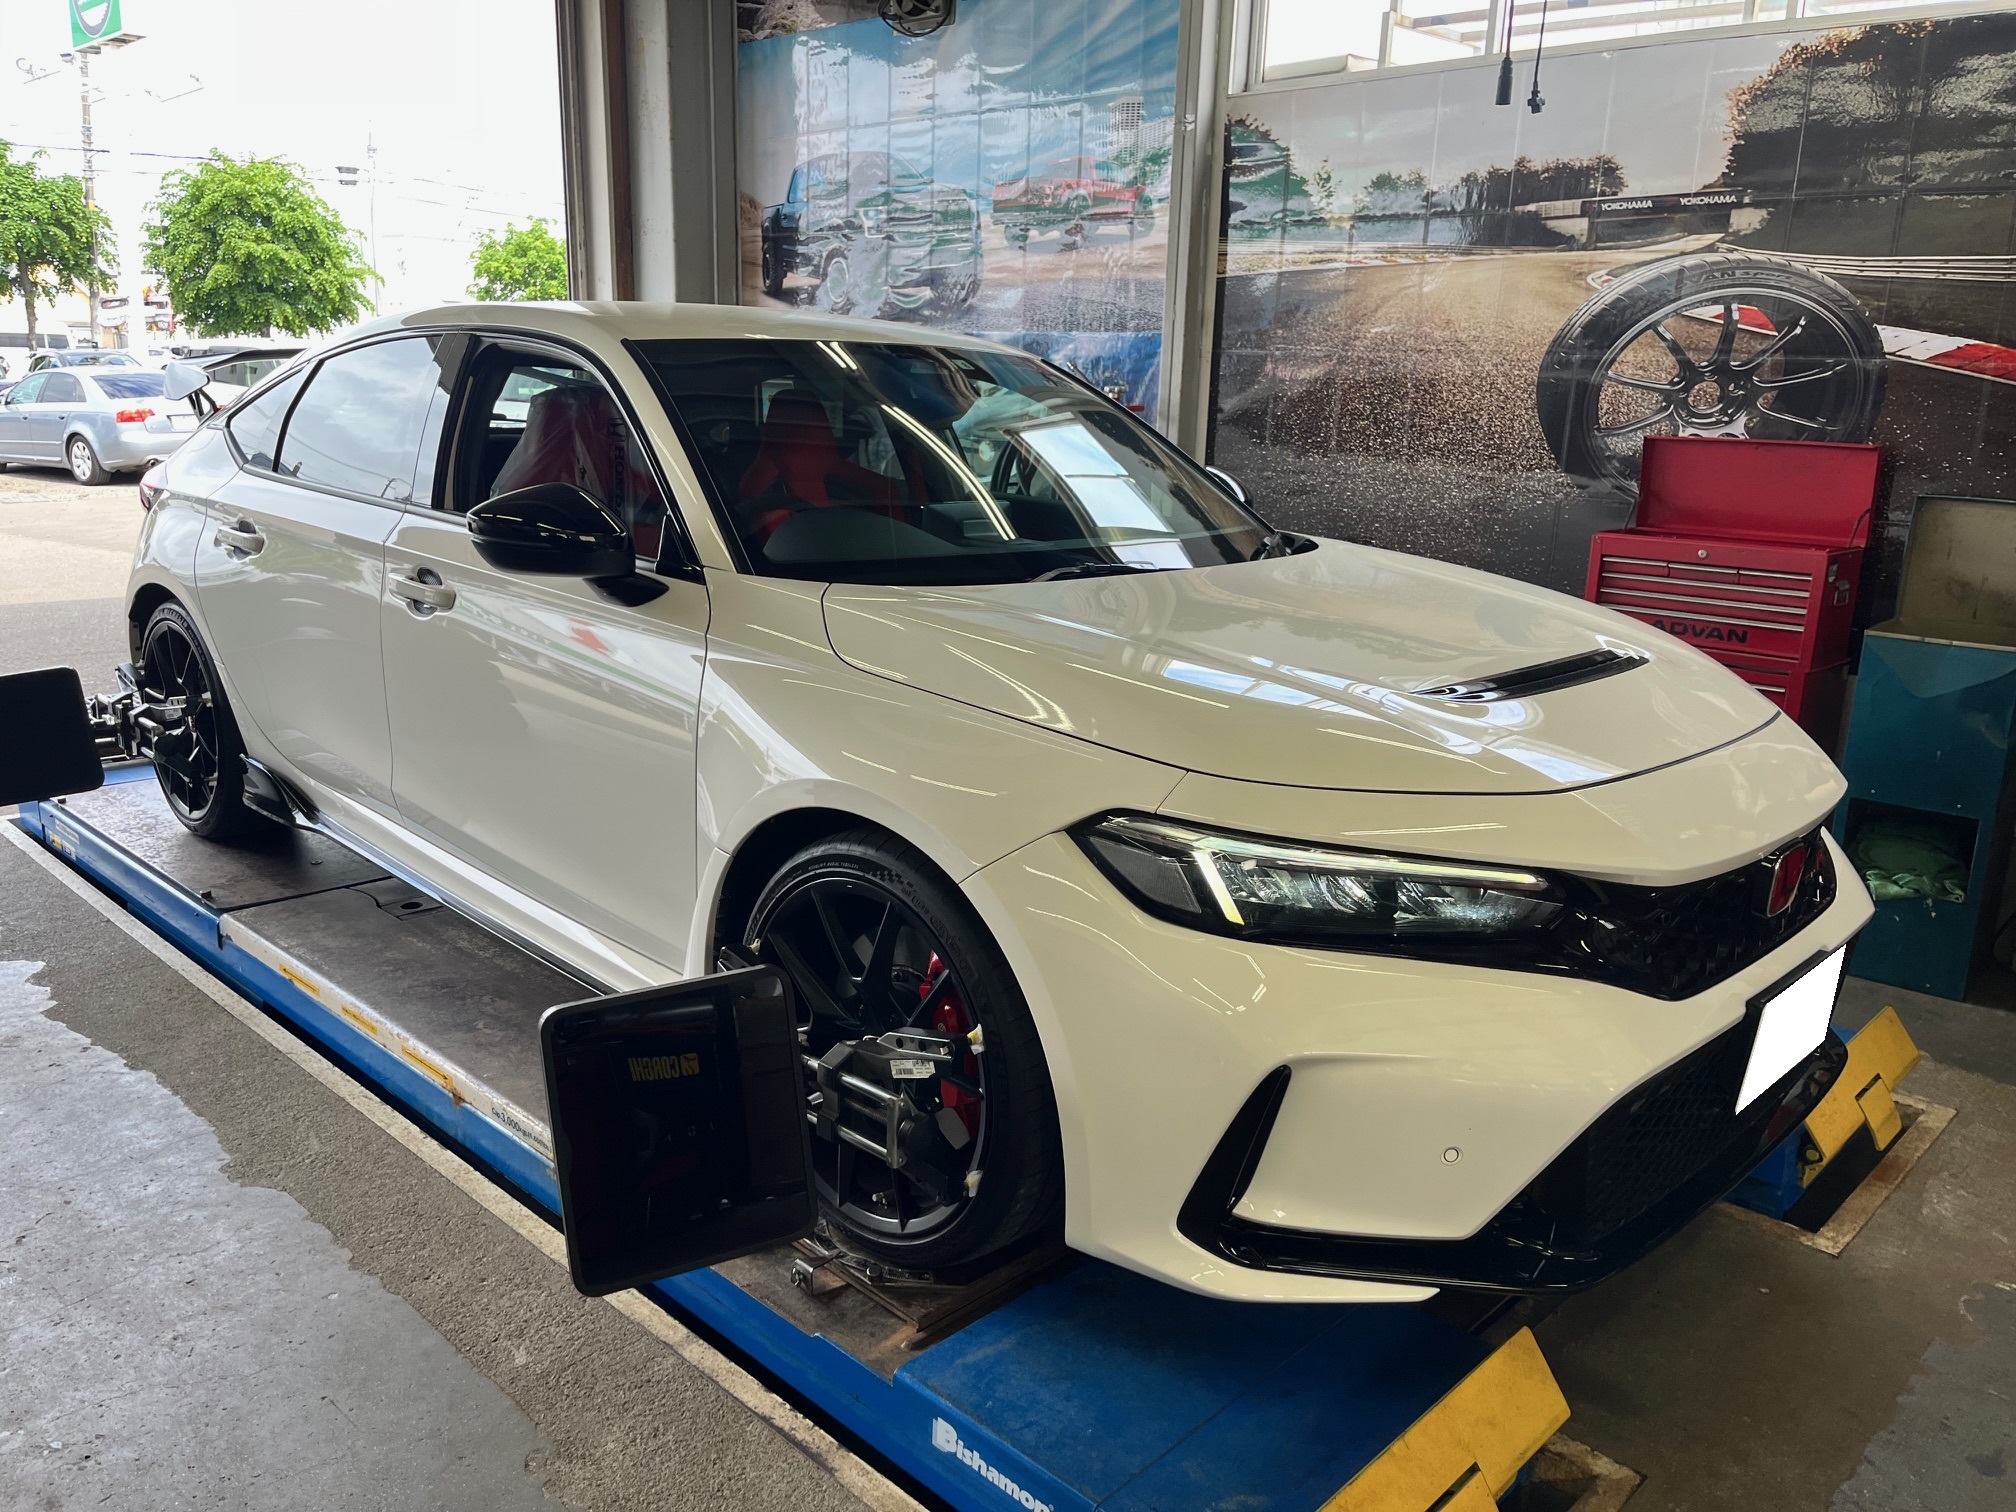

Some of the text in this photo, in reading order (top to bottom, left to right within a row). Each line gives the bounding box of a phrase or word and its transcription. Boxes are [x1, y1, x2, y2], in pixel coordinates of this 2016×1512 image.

[1601, 195, 1738, 211] YOKOHAMA YOKOHAMA
[1653, 619, 1748, 644] ADVAN
[932, 1416, 1051, 1512] Bishamon
